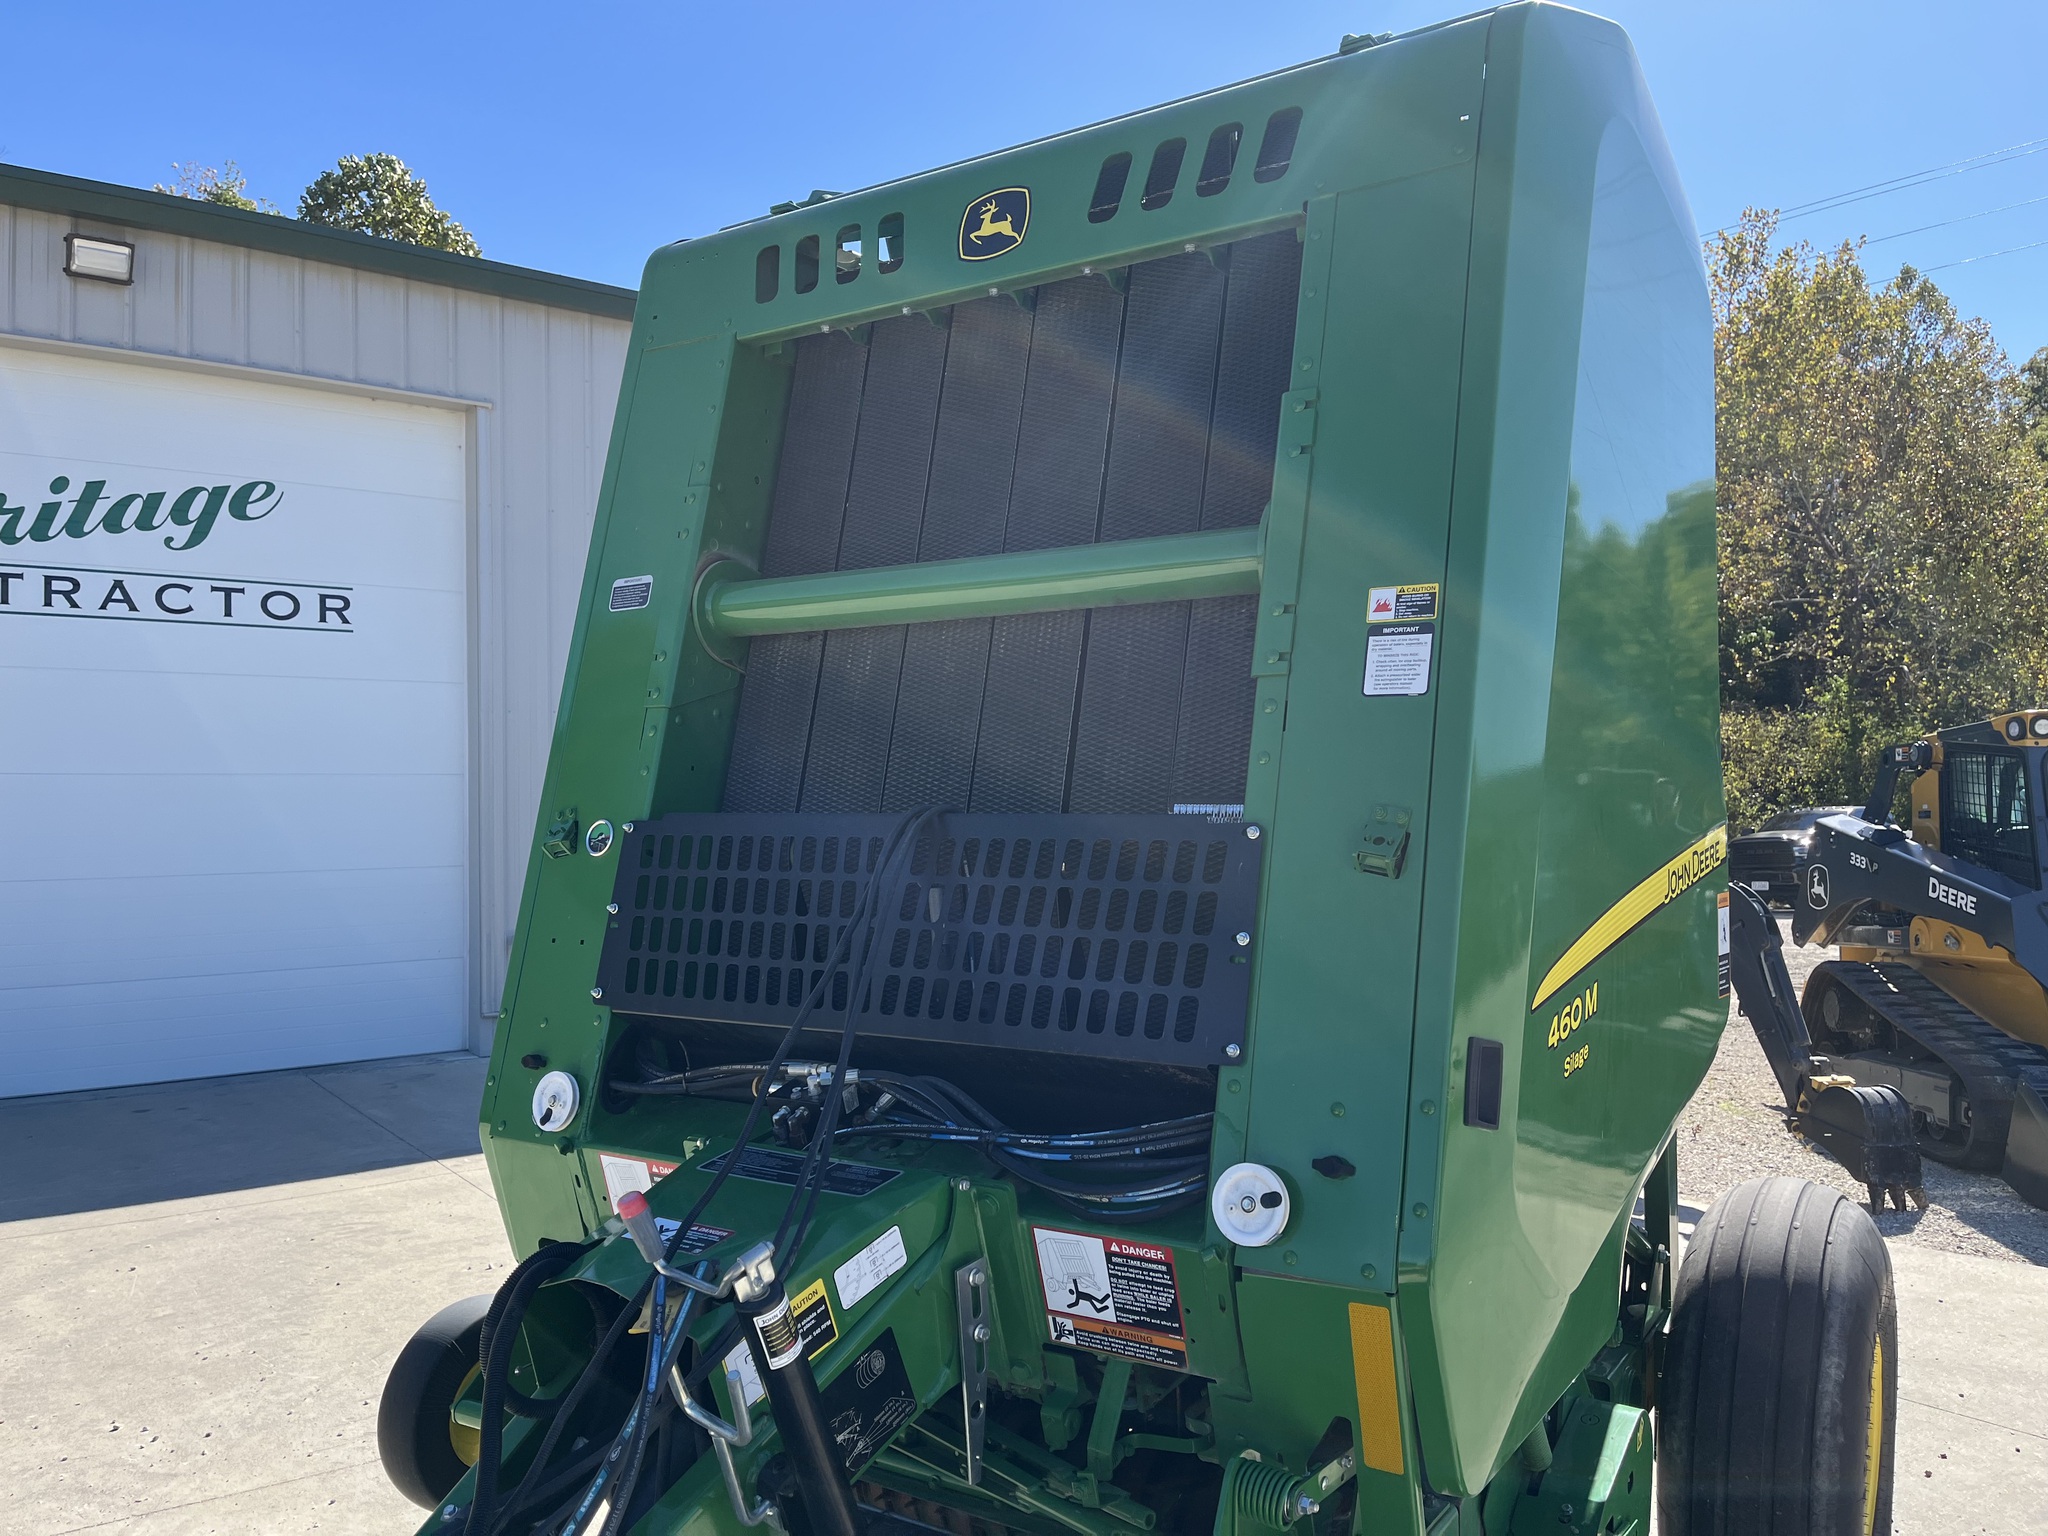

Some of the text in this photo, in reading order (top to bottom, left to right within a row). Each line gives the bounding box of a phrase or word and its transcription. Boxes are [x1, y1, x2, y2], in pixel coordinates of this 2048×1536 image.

[0, 572, 352, 624] TRACTOR
[1664, 840, 1720, 902] JOHN DEERE
[1928, 876, 1977, 915] DEERE
[1548, 981, 1598, 1048] 460 M
[1564, 1044, 1589, 1078] Silage
[698, 1227, 728, 1236] DANGER
[1122, 1244, 1165, 1260] DANGER
[792, 1289, 819, 1313] AUTION
[761, 1314, 778, 1325] JOHN
[820, 1320, 831, 1331] RPM
[1109, 1327, 1153, 1343] WARNING
